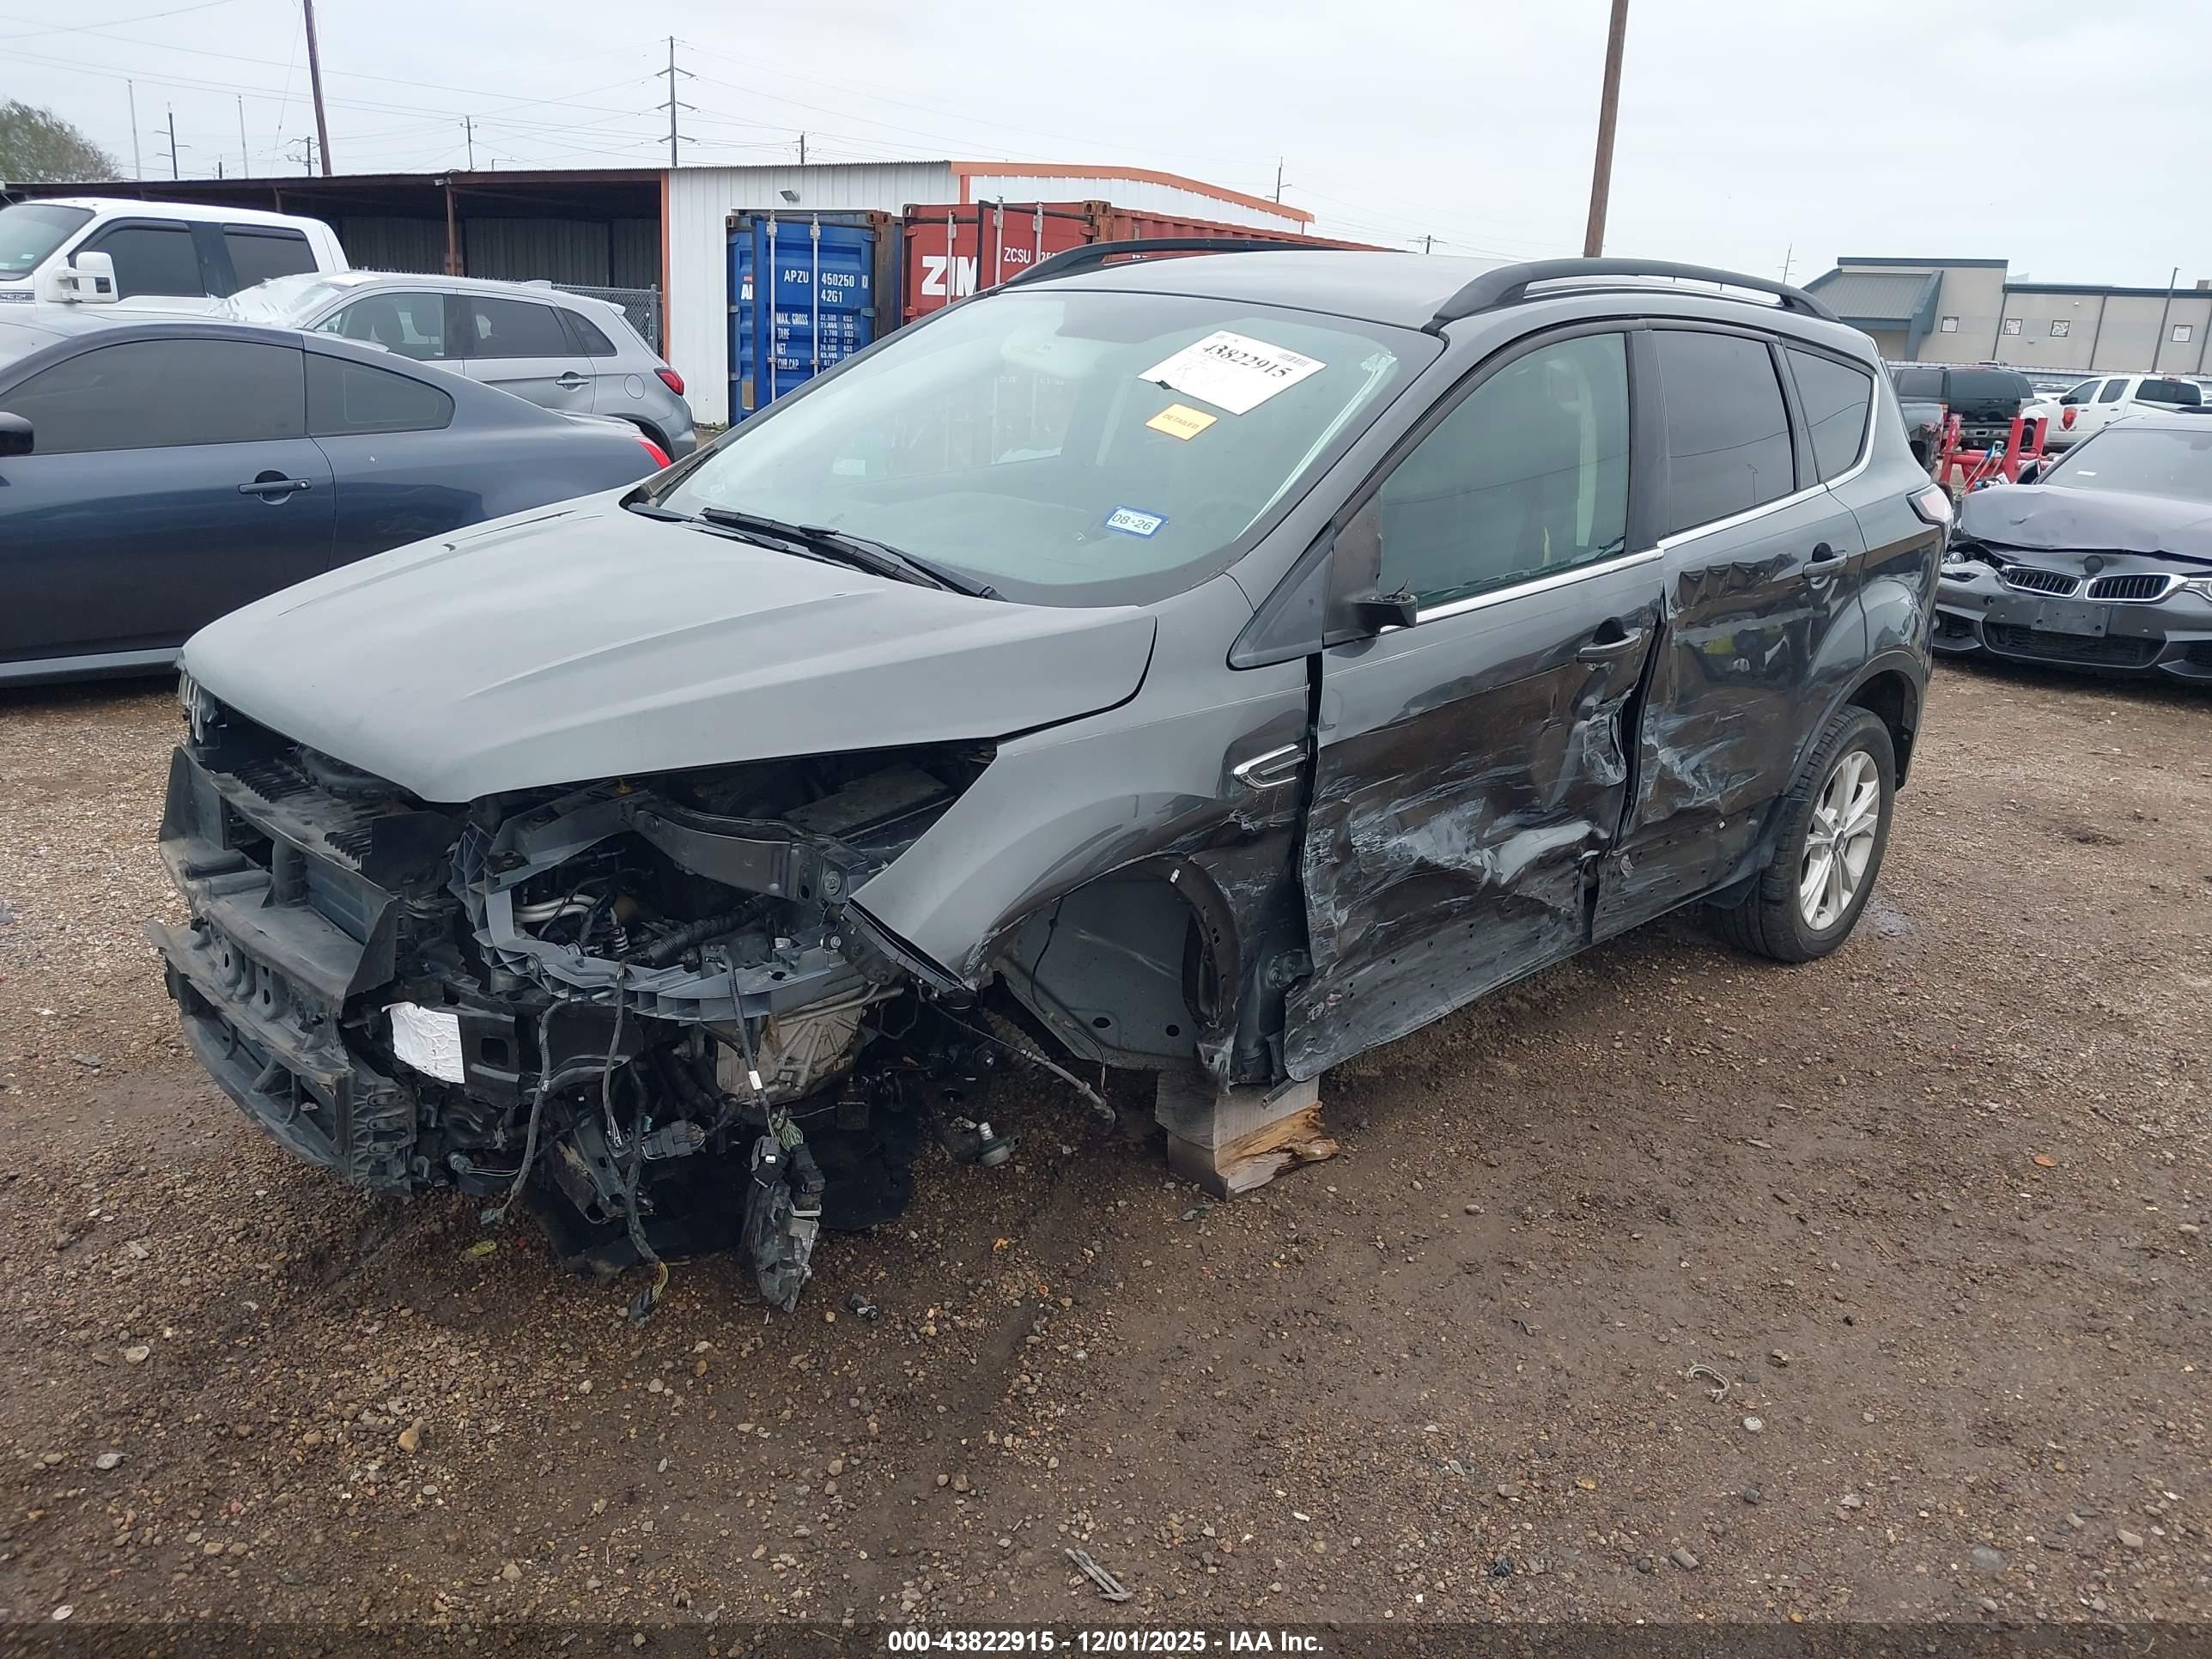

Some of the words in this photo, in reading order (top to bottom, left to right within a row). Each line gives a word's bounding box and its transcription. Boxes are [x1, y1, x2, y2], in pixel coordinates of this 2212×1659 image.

[1004, 246, 1031, 264] ZCSU
[784, 270, 809, 283] APZU
[821, 272, 855, 288] 450250
[921, 255, 977, 296] ZIM
[821, 289, 842, 303] 42G1
[776, 313, 791, 325] MAX.
[792, 313, 809, 325] GROSS
[777, 327, 791, 340] TARE
[775, 343, 787, 356] NET
[1202, 343, 1293, 378] 43822915
[1163, 413, 1200, 430] DETAILED
